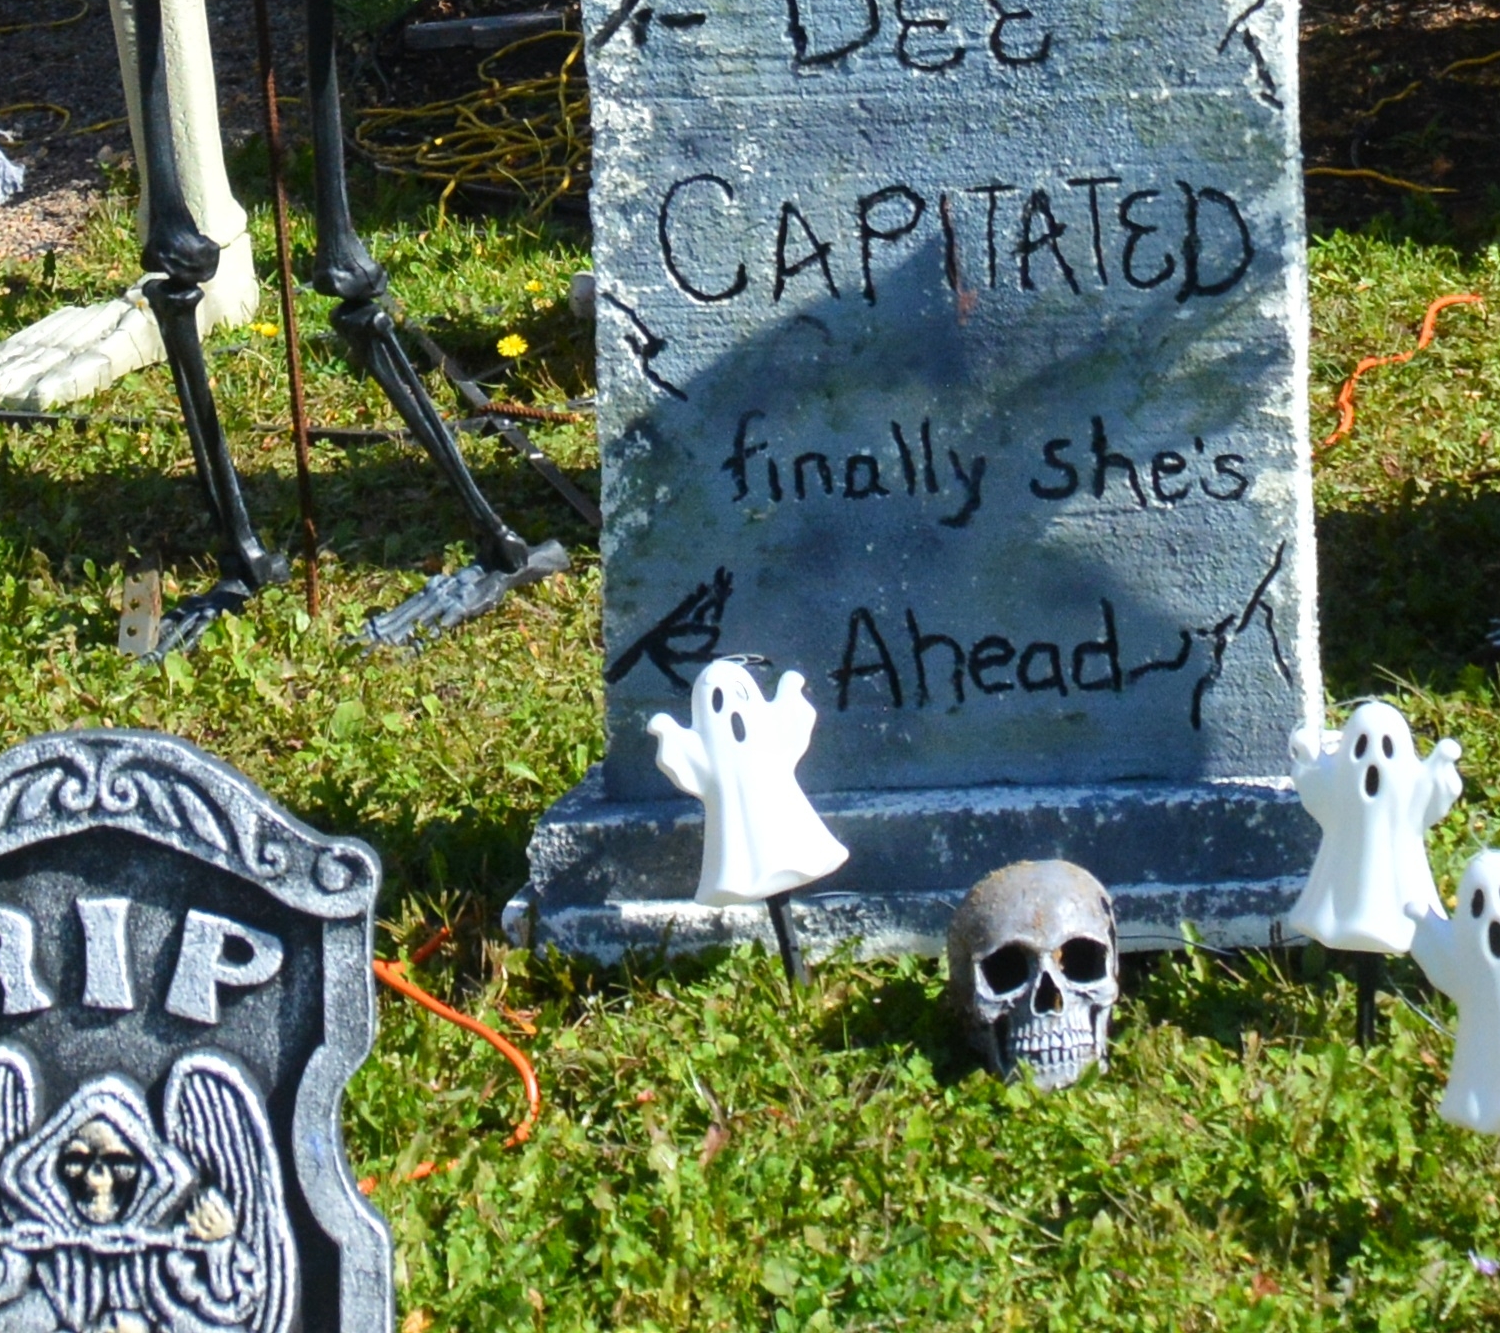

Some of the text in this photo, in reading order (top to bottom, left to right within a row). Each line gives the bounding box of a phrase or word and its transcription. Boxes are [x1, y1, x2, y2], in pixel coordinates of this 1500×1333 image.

[656, 171, 1257, 309] CAPITATED
[719, 408, 1250, 529] finally she's
[828, 596, 1128, 713] Ahead
